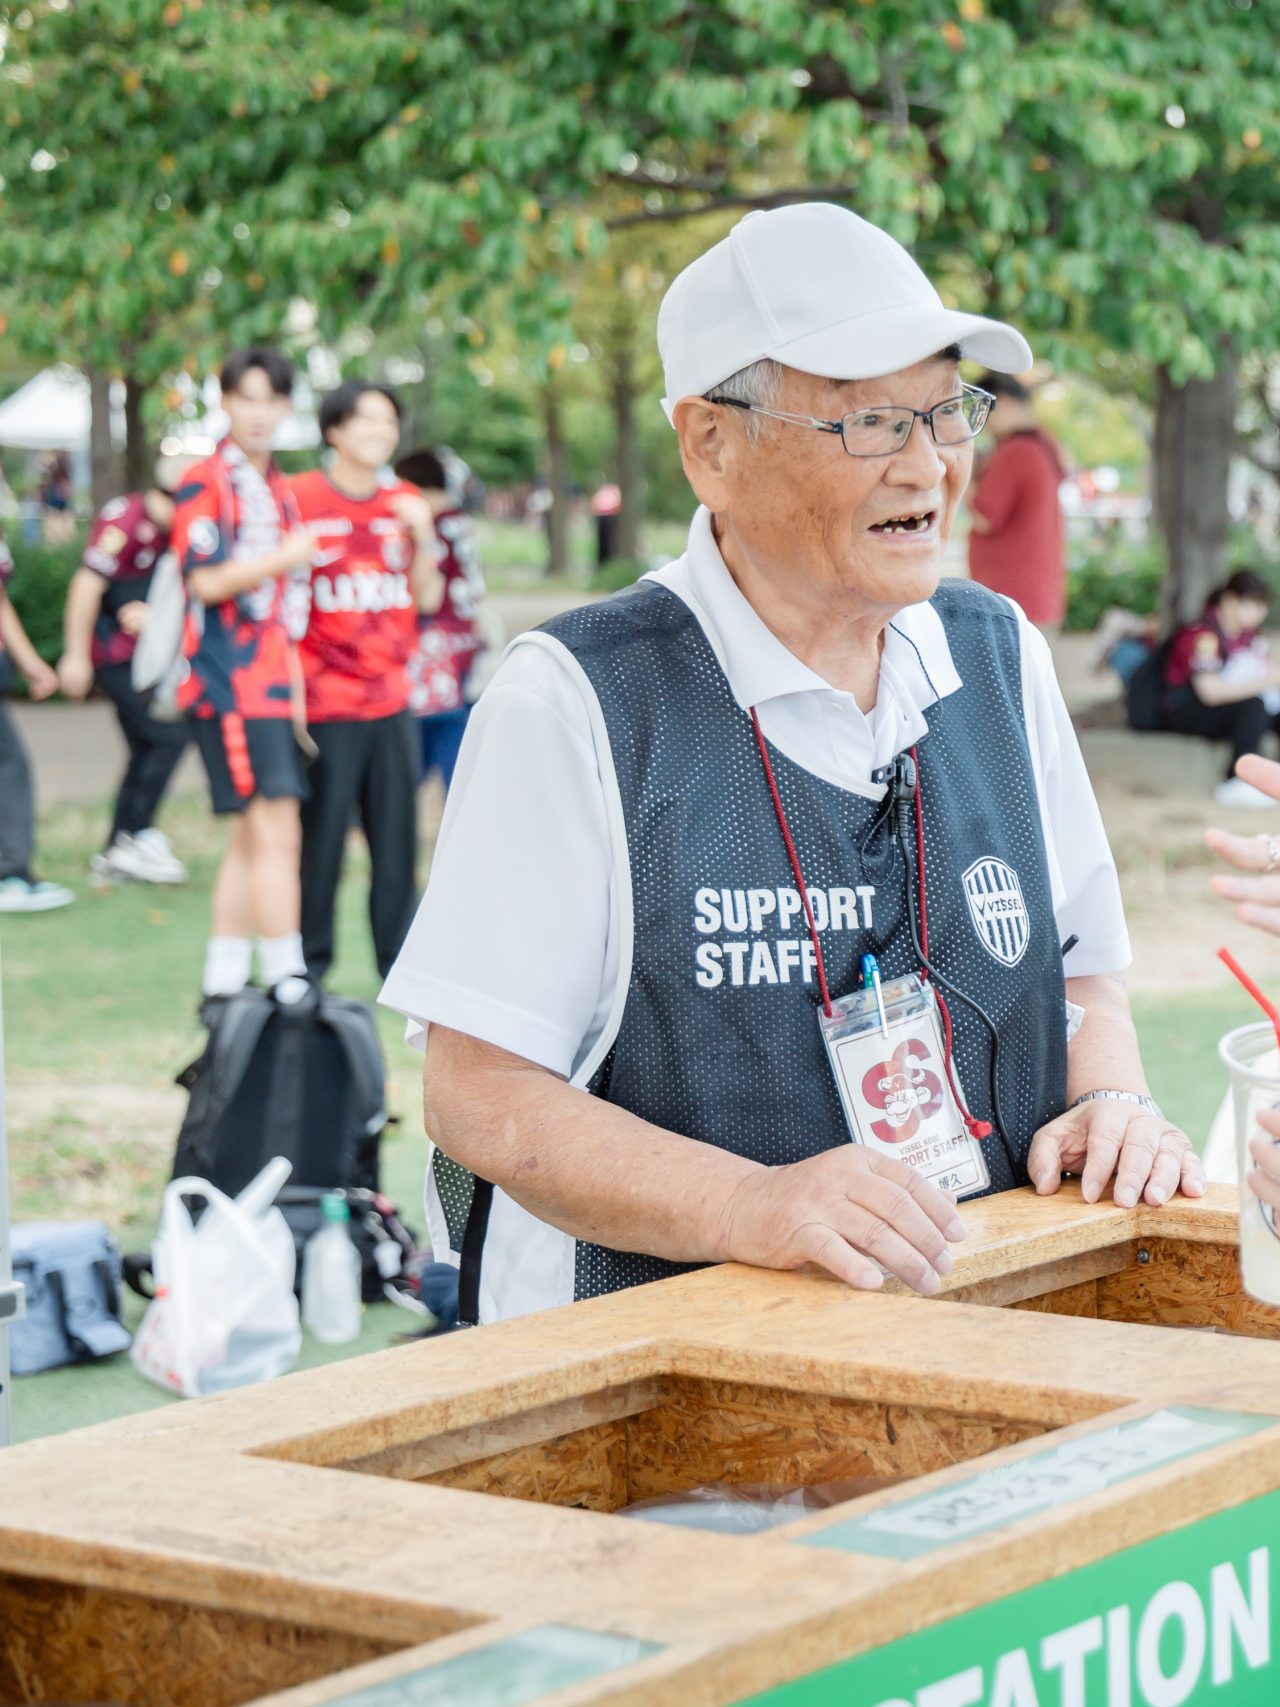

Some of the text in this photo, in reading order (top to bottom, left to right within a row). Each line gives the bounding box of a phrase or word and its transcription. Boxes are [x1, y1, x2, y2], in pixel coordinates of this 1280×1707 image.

[694, 885, 876, 934] SUPPORT
[696, 940, 819, 988] STAFF
[871, 1545, 1270, 1707] TION
